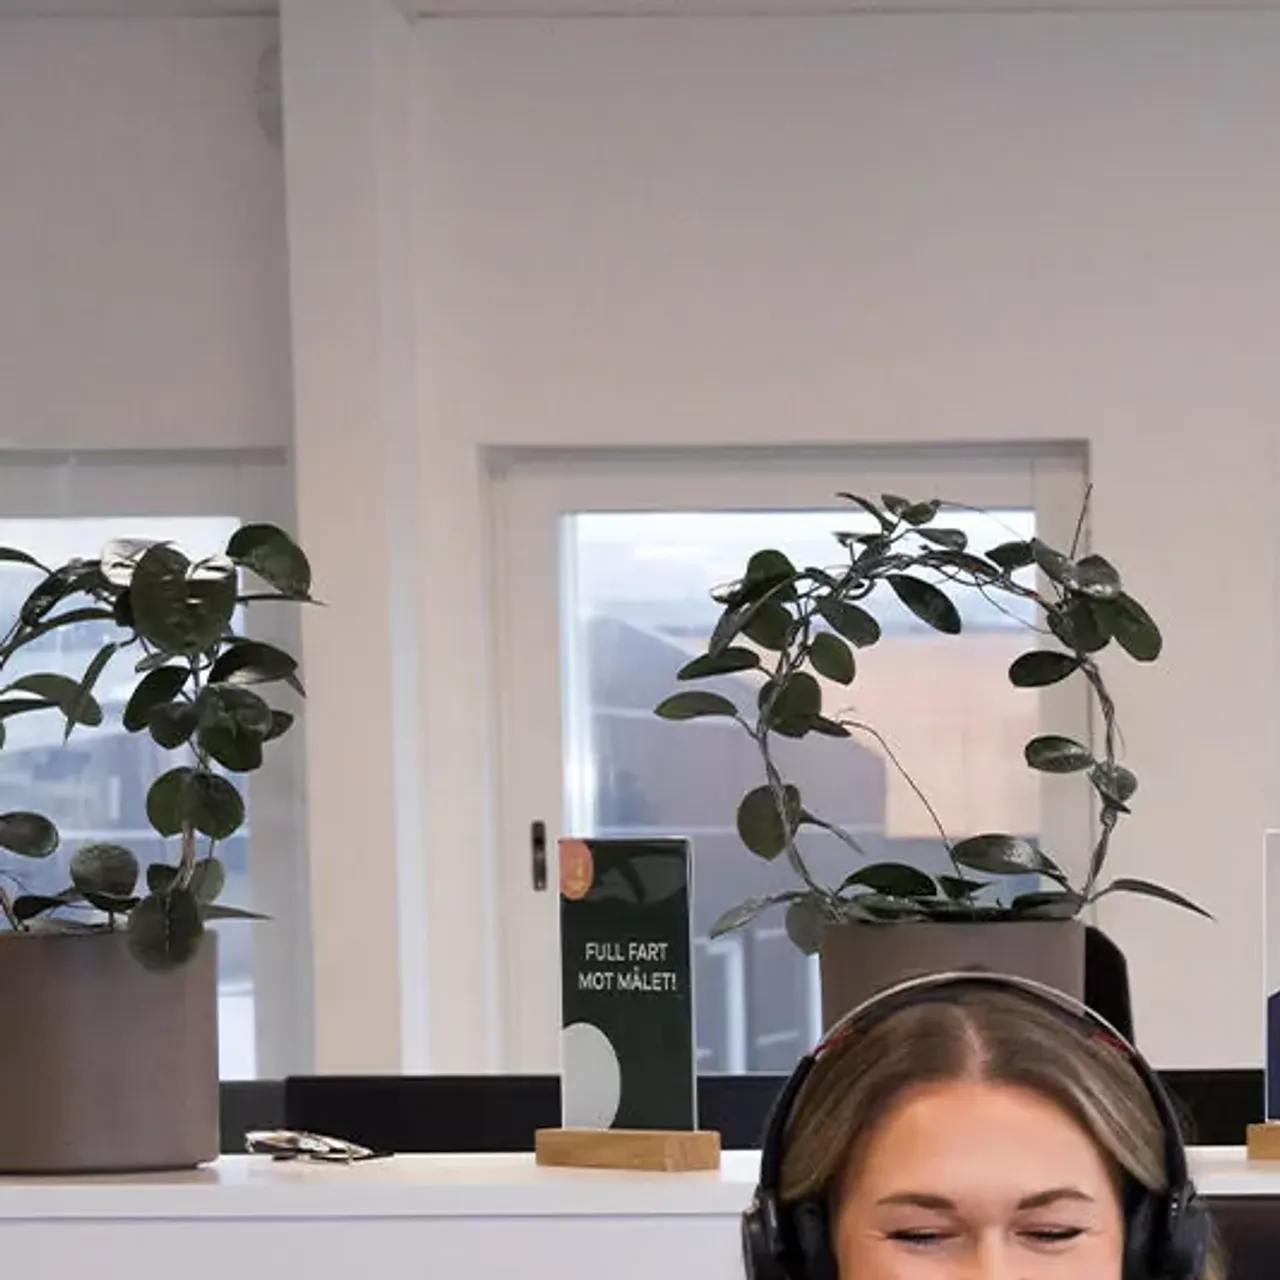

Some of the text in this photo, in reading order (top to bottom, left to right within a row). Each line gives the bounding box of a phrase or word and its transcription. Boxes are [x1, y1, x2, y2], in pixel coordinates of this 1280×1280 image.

[585, 942, 668, 961] FULL FART
[578, 965, 676, 991] MOT MÅLET!
